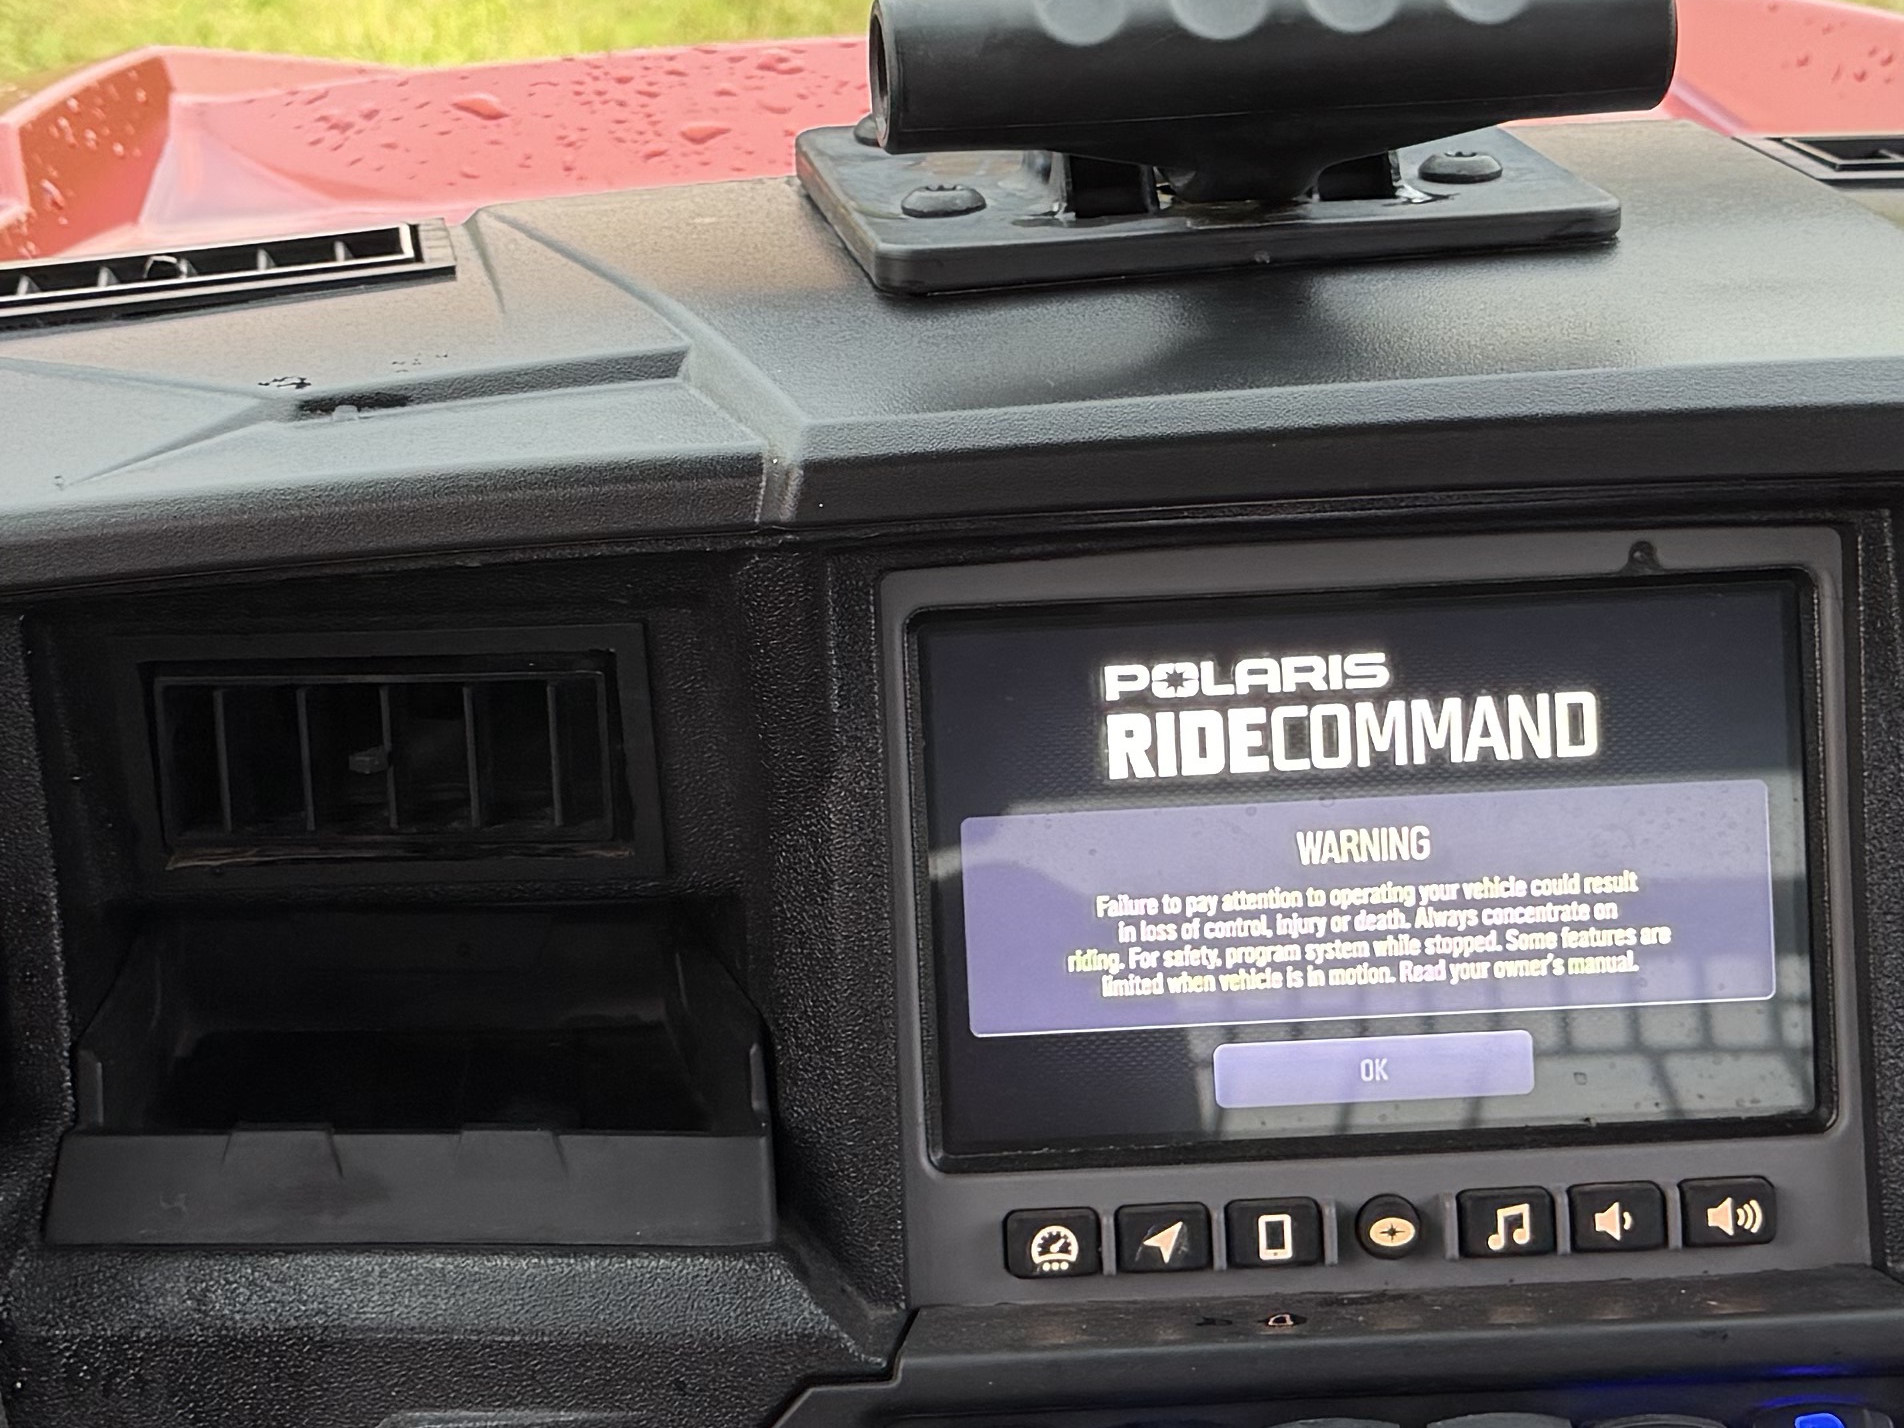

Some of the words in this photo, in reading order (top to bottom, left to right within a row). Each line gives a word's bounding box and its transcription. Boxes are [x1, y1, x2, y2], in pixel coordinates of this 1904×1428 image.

[1104, 652, 1390, 701] POLARIS
[1296, 825, 1431, 866] WARNING
[1096, 894, 1159, 917] Failure
[1162, 894, 1182, 915] to
[1186, 894, 1218, 917] pay
[1221, 887, 1303, 913] attention
[1306, 887, 1326, 907] to
[1330, 881, 1415, 909] operating
[1418, 881, 1460, 906] your
[1462, 876, 1527, 900] vehicle
[1531, 873, 1580, 897] could
[1584, 870, 1639, 894] result
[1118, 921, 1136, 943] in
[1140, 920, 1177, 941] loss
[1181, 917, 1201, 940] of
[1204, 914, 1273, 938] control,
[1276, 912, 1327, 938] injury
[1330, 915, 1351, 932] or
[1354, 908, 1411, 931] death.
[1415, 905, 1478, 931] Always
[1482, 901, 1590, 925] concentrate
[1593, 902, 1618, 920] on
[1067, 949, 1125, 973] riding.
[1128, 946, 1160, 969] For
[1225, 942, 1301, 966] program
[1304, 939, 1369, 963] system
[1373, 934, 1421, 957] while
[1424, 930, 1503, 957] stopped.
[1505, 928, 1558, 951] Some
[1561, 925, 1637, 948] features
[1640, 925, 1672, 945] are
[1101, 972, 1164, 997] limited
[1167, 971, 1216, 993] when
[1219, 968, 1283, 991] vehicle
[1286, 965, 1304, 988] is
[1307, 964, 1325, 986] in
[1328, 962, 1396, 986] motion.
[1400, 959, 1446, 983] Read
[1449, 960, 1492, 985] your
[1567, 949, 1639, 975] manual.
[1360, 1058, 1388, 1082] OK
